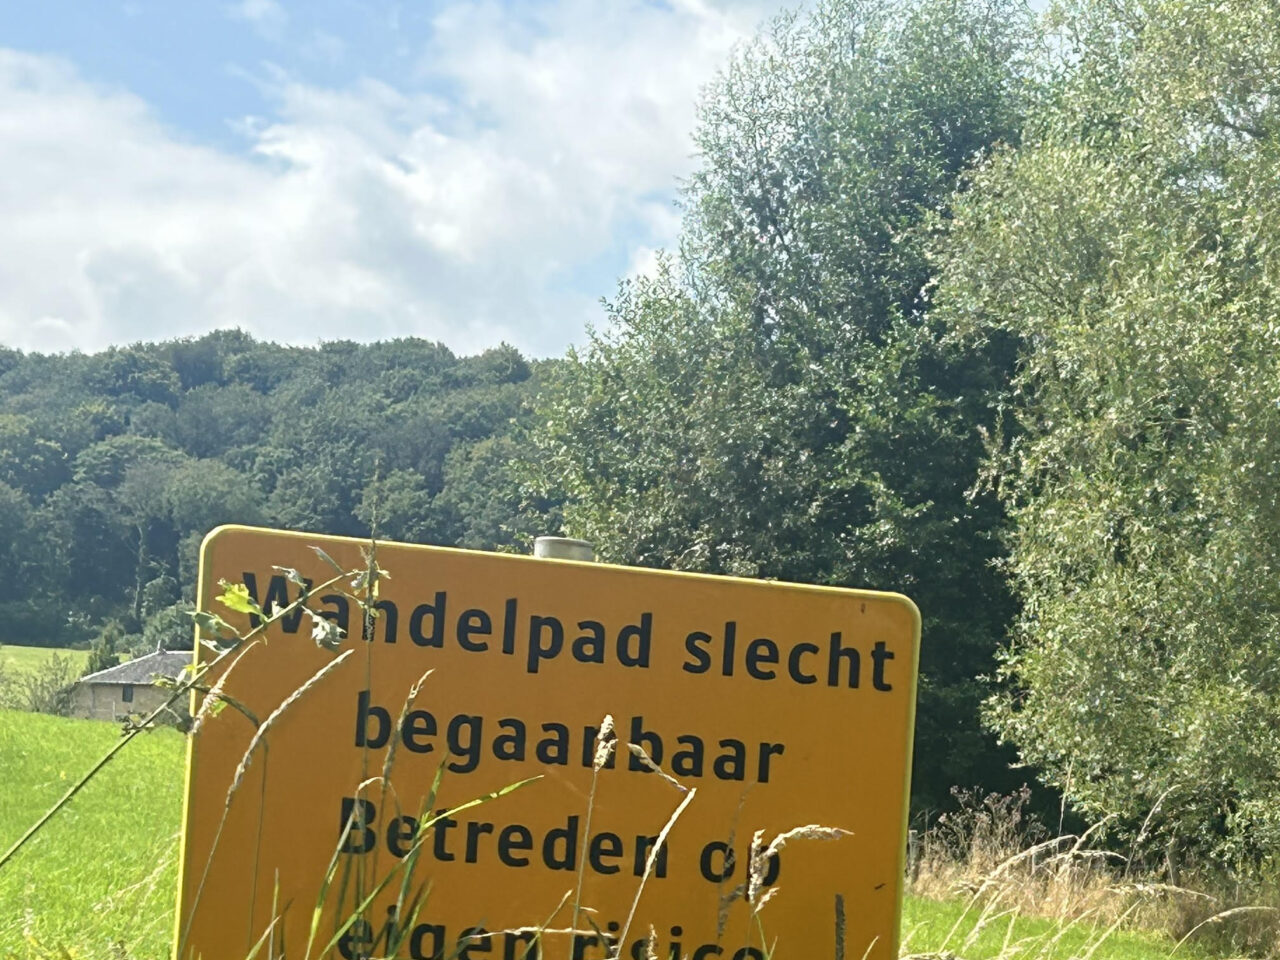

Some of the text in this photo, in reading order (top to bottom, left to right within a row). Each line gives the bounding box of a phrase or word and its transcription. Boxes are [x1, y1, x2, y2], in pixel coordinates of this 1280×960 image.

[242, 571, 895, 692] Wandelpad slecht
[354, 690, 785, 783] begaanbaar
[339, 796, 668, 878] Betreden
